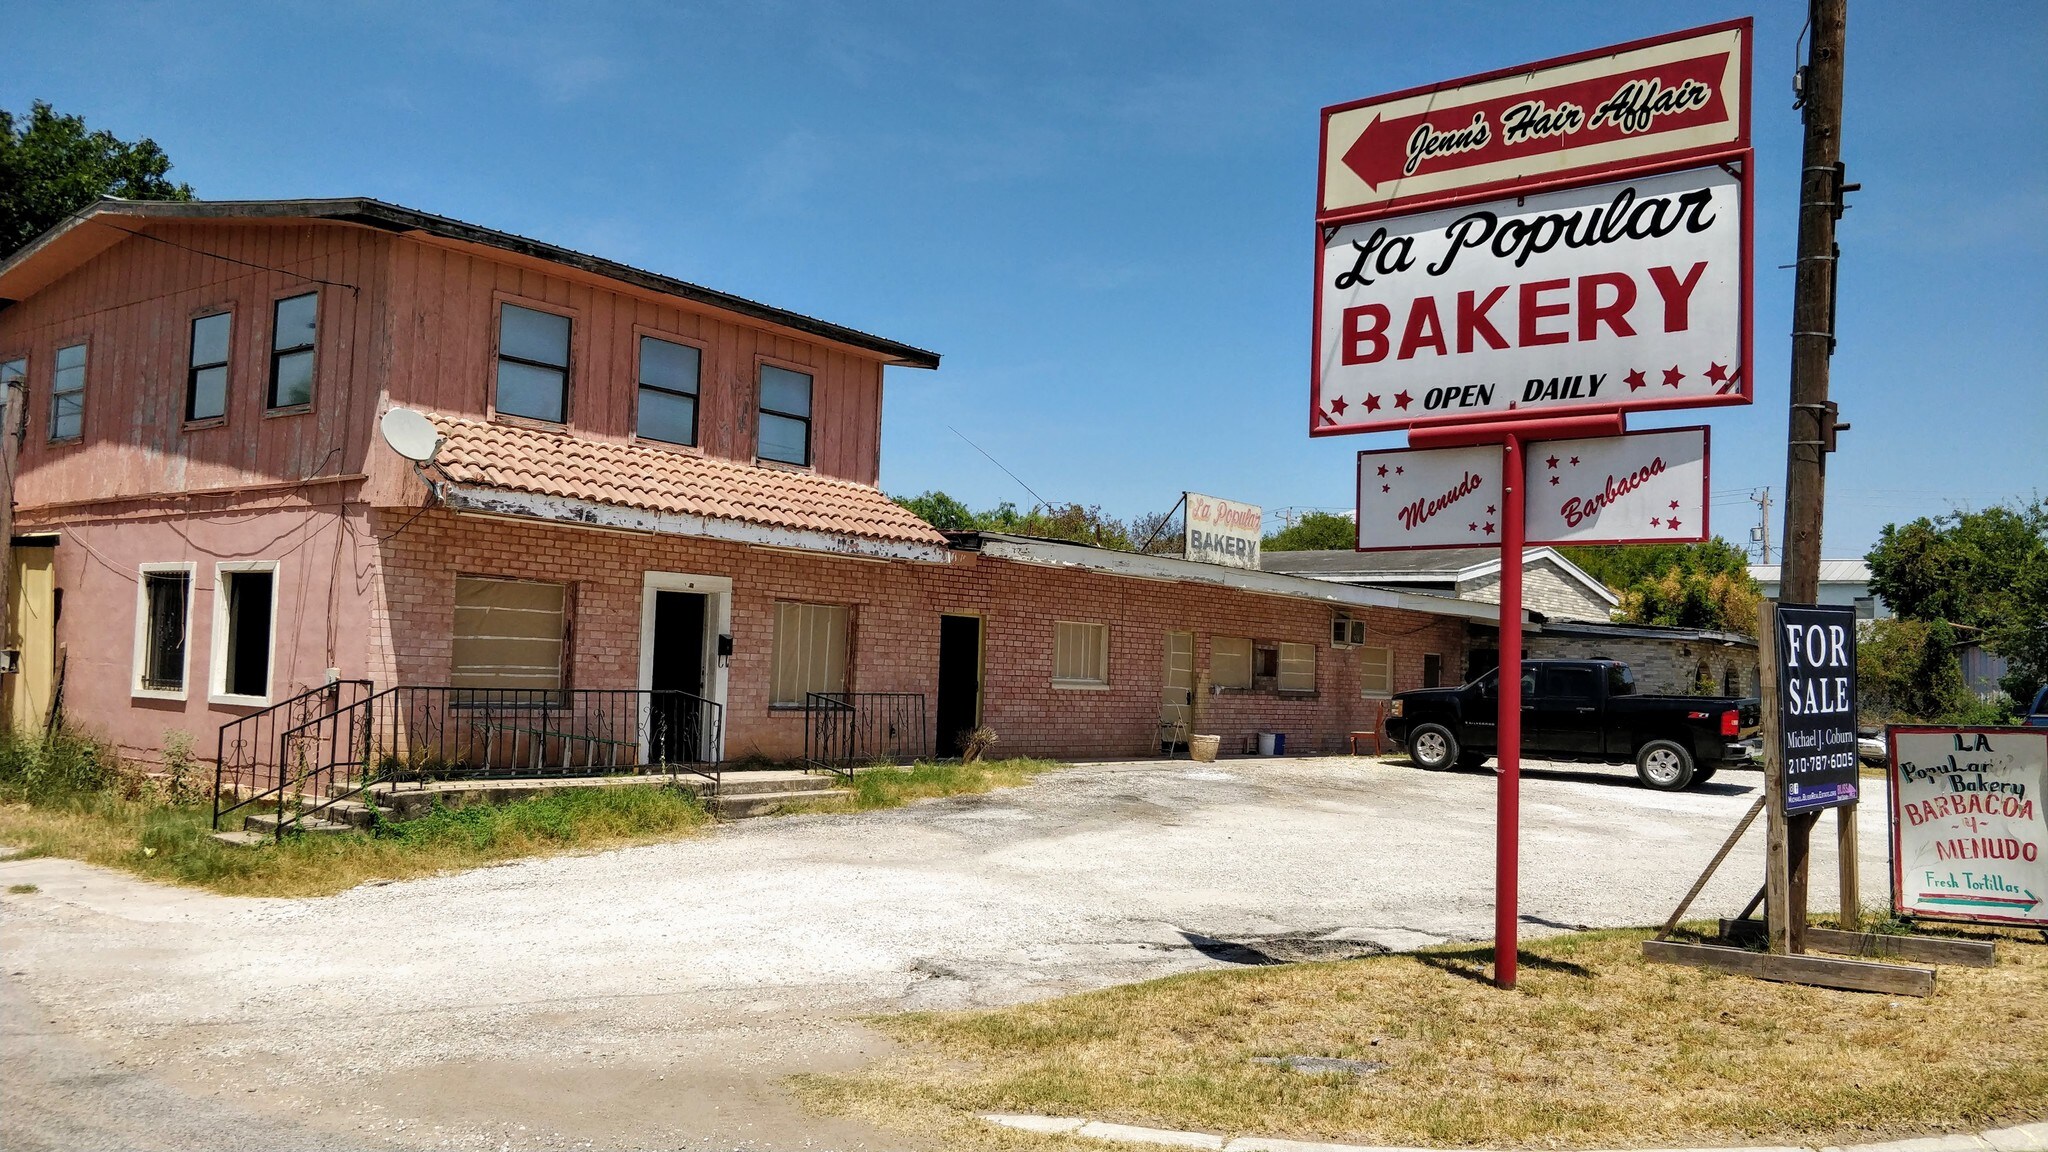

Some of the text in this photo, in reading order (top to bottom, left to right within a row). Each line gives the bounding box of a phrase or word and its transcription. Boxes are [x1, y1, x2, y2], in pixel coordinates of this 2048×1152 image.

[1403, 78, 1711, 176] Jenn's Hair Affair
[1334, 187, 1717, 290] La Popular
[1340, 261, 1709, 367] BAKERY
[1423, 373, 1608, 411] OPEN DAILY
[1398, 472, 1483, 531] Menudo
[1560, 456, 1668, 528] Barbacoa
[1191, 498, 1261, 534] La Popular
[1191, 529, 1257, 560] BAKERY
[1786, 624, 1849, 668] FOR
[1788, 677, 1849, 716] SALE
[1787, 727, 1853, 752] Michael J. Coburn
[1953, 733, 1995, 752] LA
[1948, 773, 2026, 802] Bakery
[1904, 793, 2034, 827] BARBACOA
[1935, 838, 2038, 862] MENUDO
[1925, 871, 2020, 893] Fresh Tortillas
